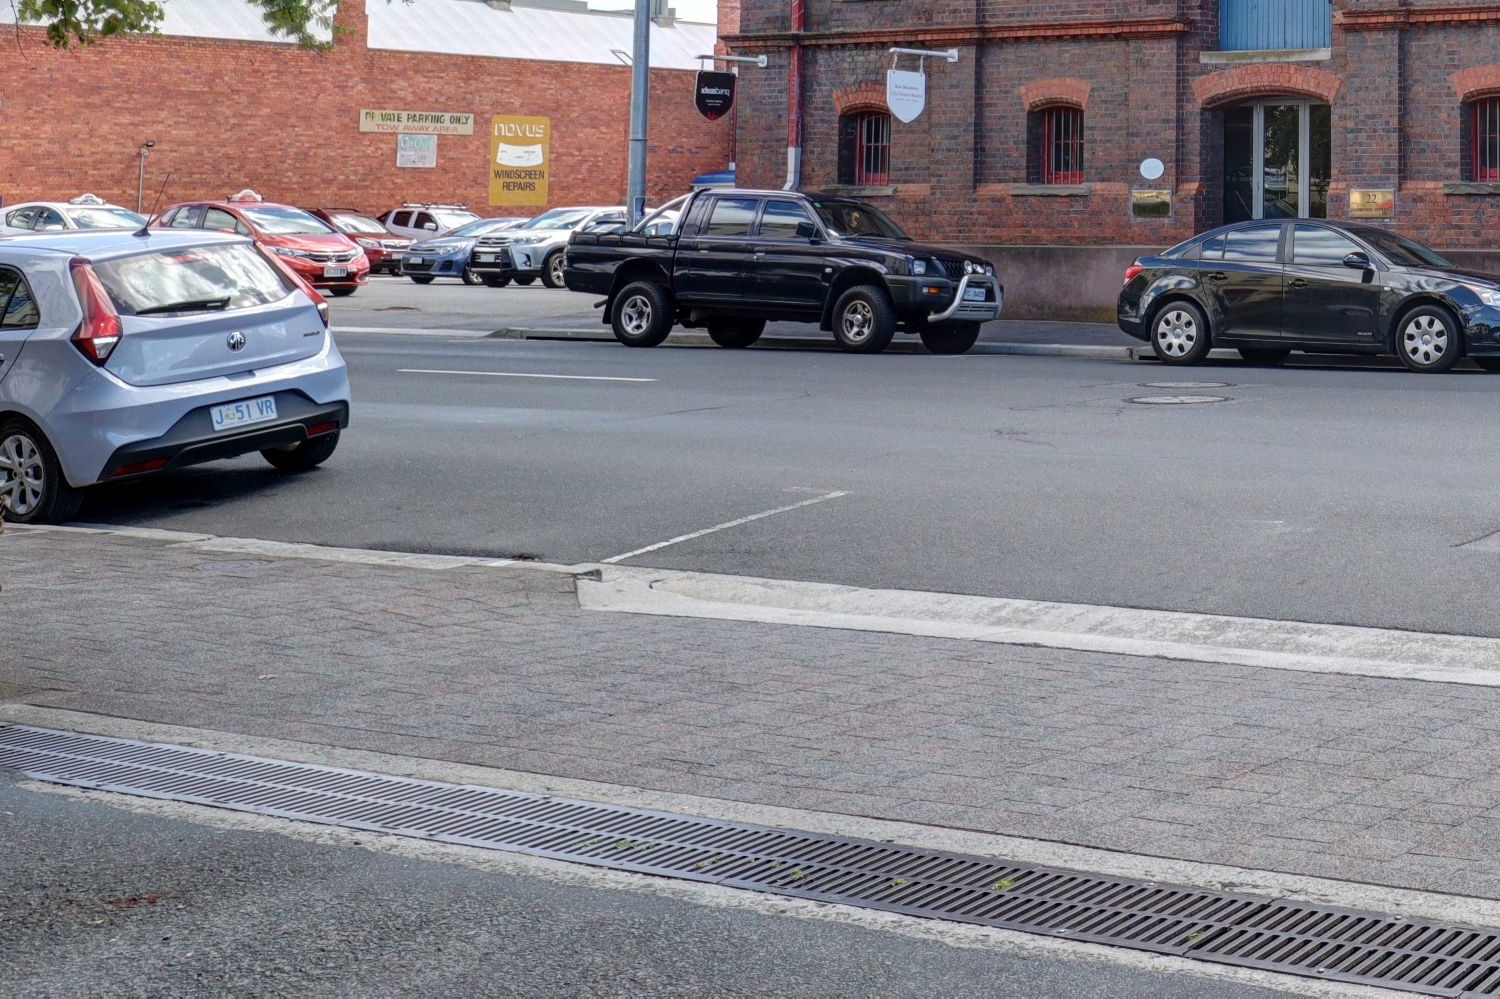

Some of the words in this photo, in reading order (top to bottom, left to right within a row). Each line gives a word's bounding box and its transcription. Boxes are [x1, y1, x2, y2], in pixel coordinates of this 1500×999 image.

[365, 112, 402, 122] PRIVATE
[407, 113, 445, 124] PARKING
[448, 115, 470, 125] ONLY
[494, 170, 545, 180] WINDSCREEN
[502, 182, 536, 192] REPAIRS
[1366, 194, 1377, 204] 22
[216, 409, 224, 425] J
[235, 403, 252, 420] 51
[256, 400, 274, 416] VR
